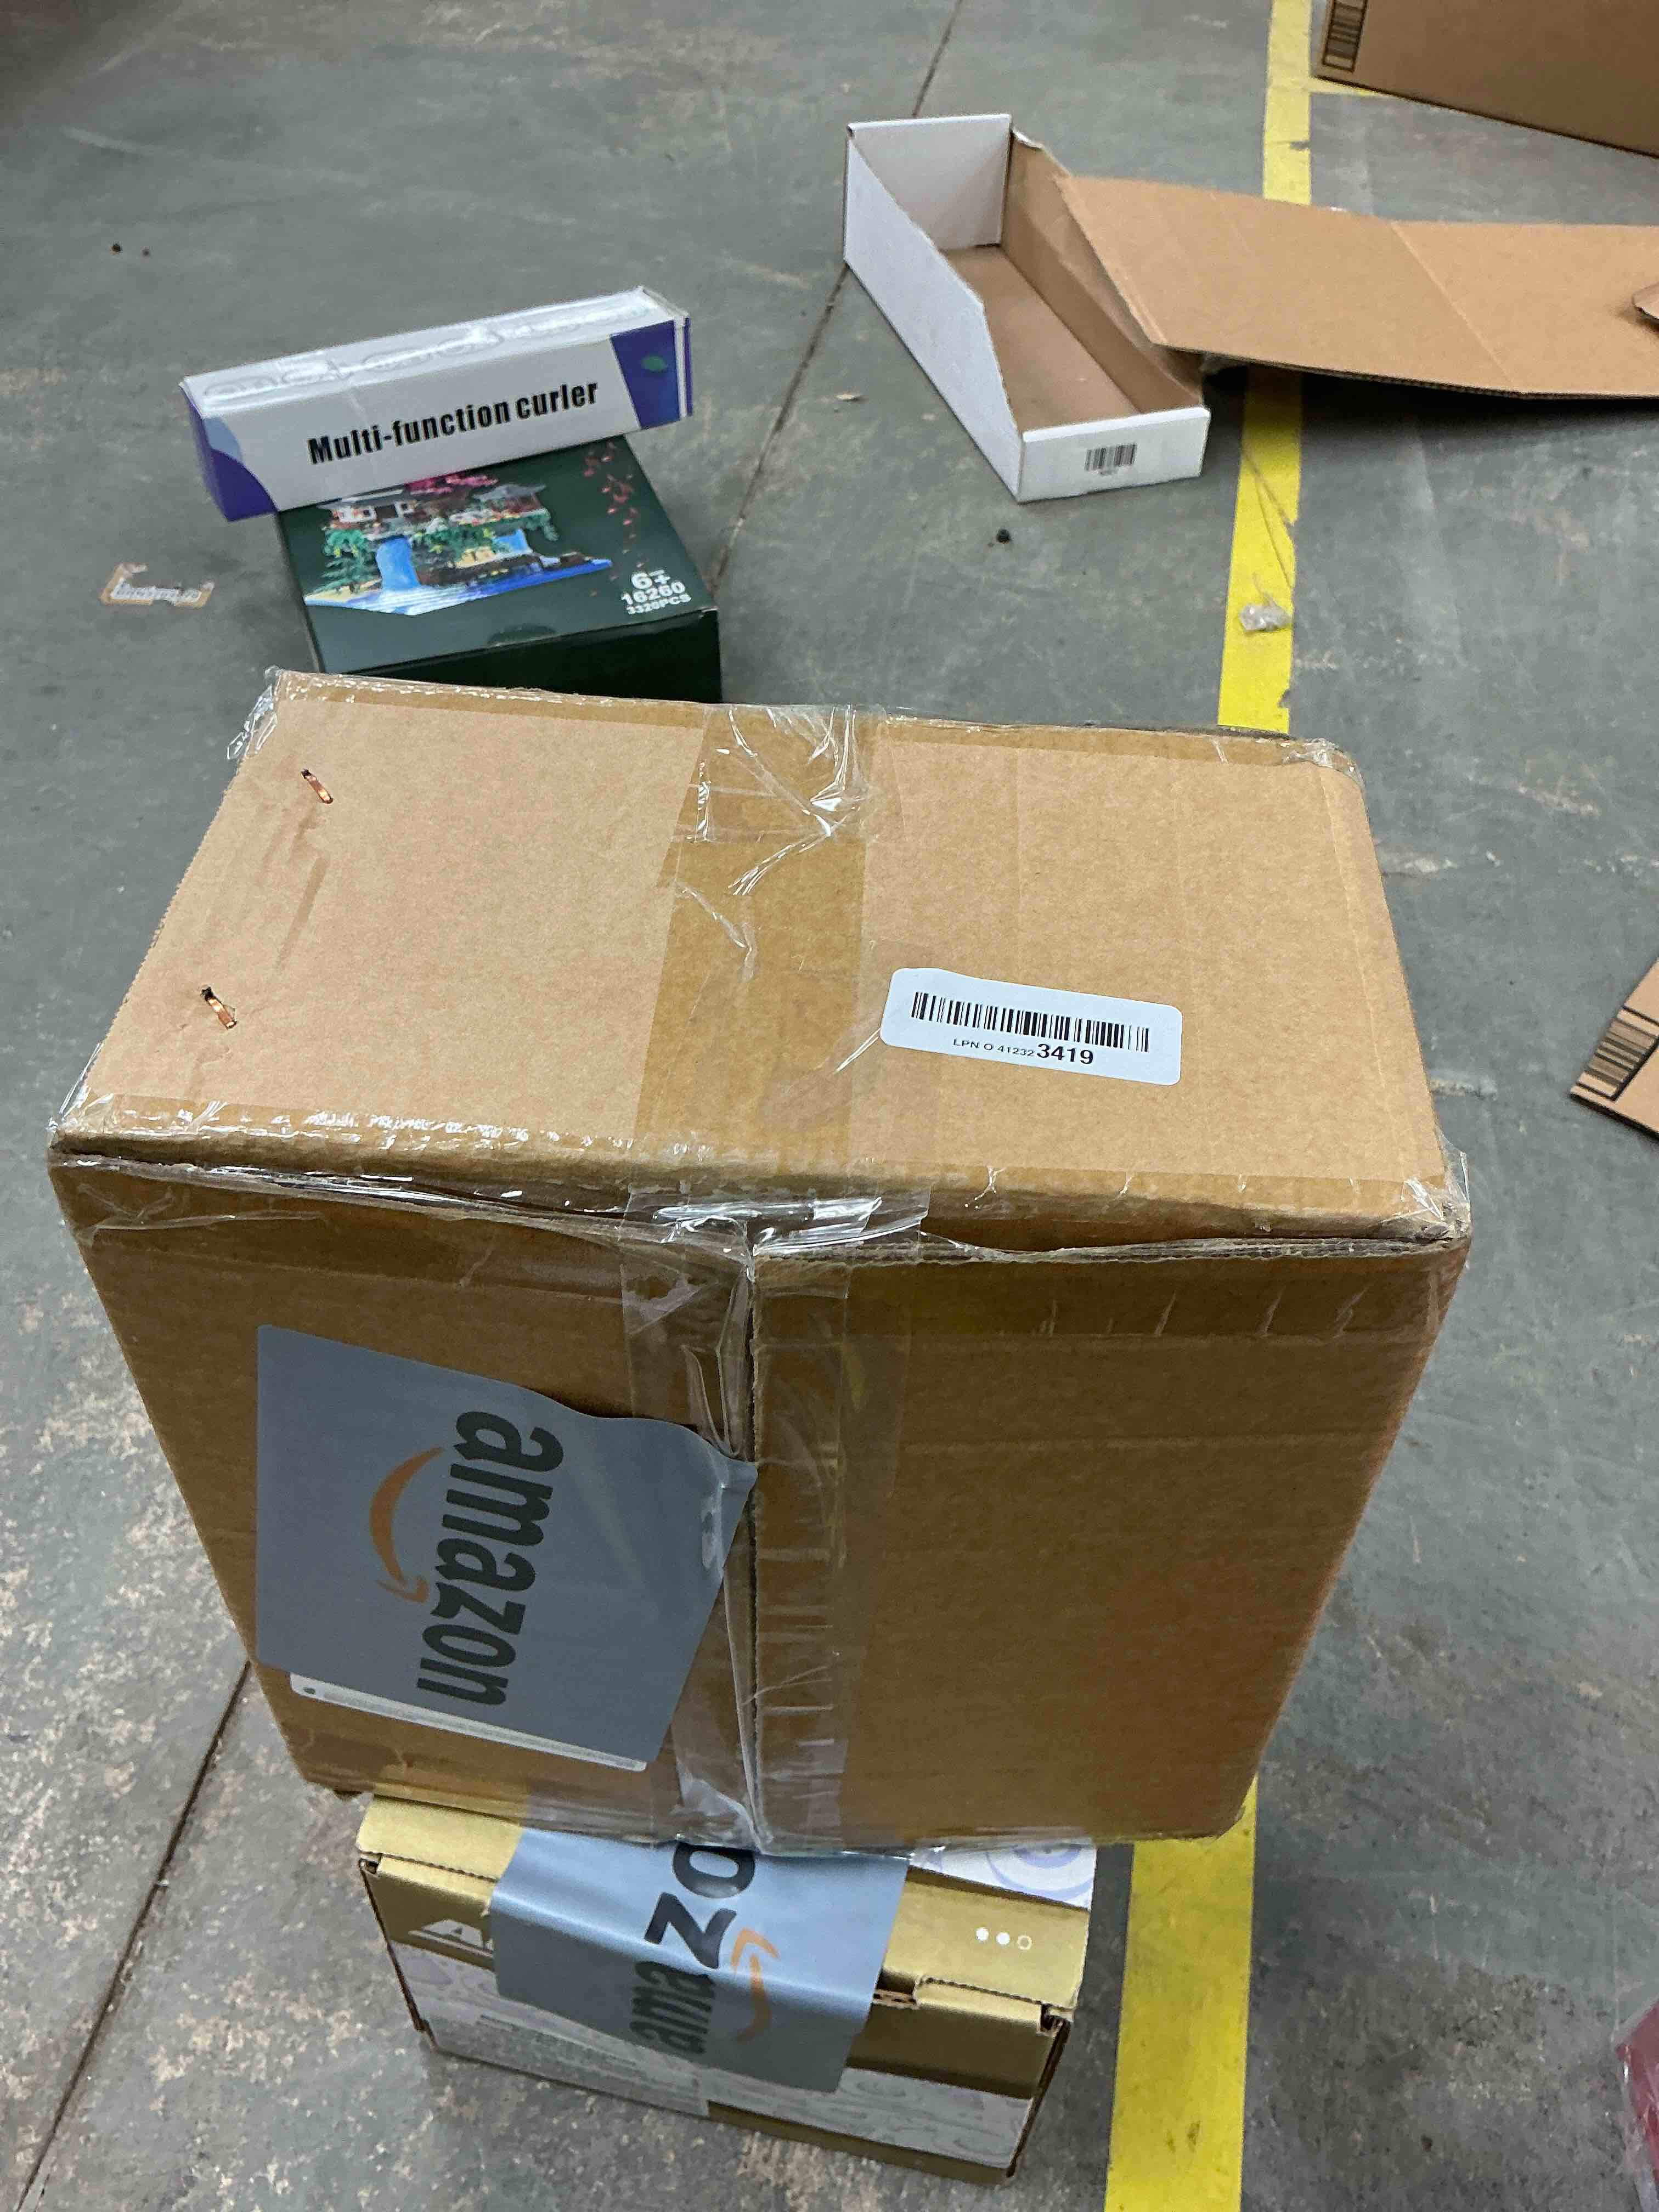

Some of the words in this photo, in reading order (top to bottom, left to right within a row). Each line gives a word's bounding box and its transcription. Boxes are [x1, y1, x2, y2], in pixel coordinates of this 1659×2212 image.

[307, 400, 511, 465] Multi-function
[515, 382, 599, 420] curler
[952, 1038, 980, 1049] LPN
[416, 1410, 565, 1706] amazon
[629, 1842, 757, 2055] amazo
